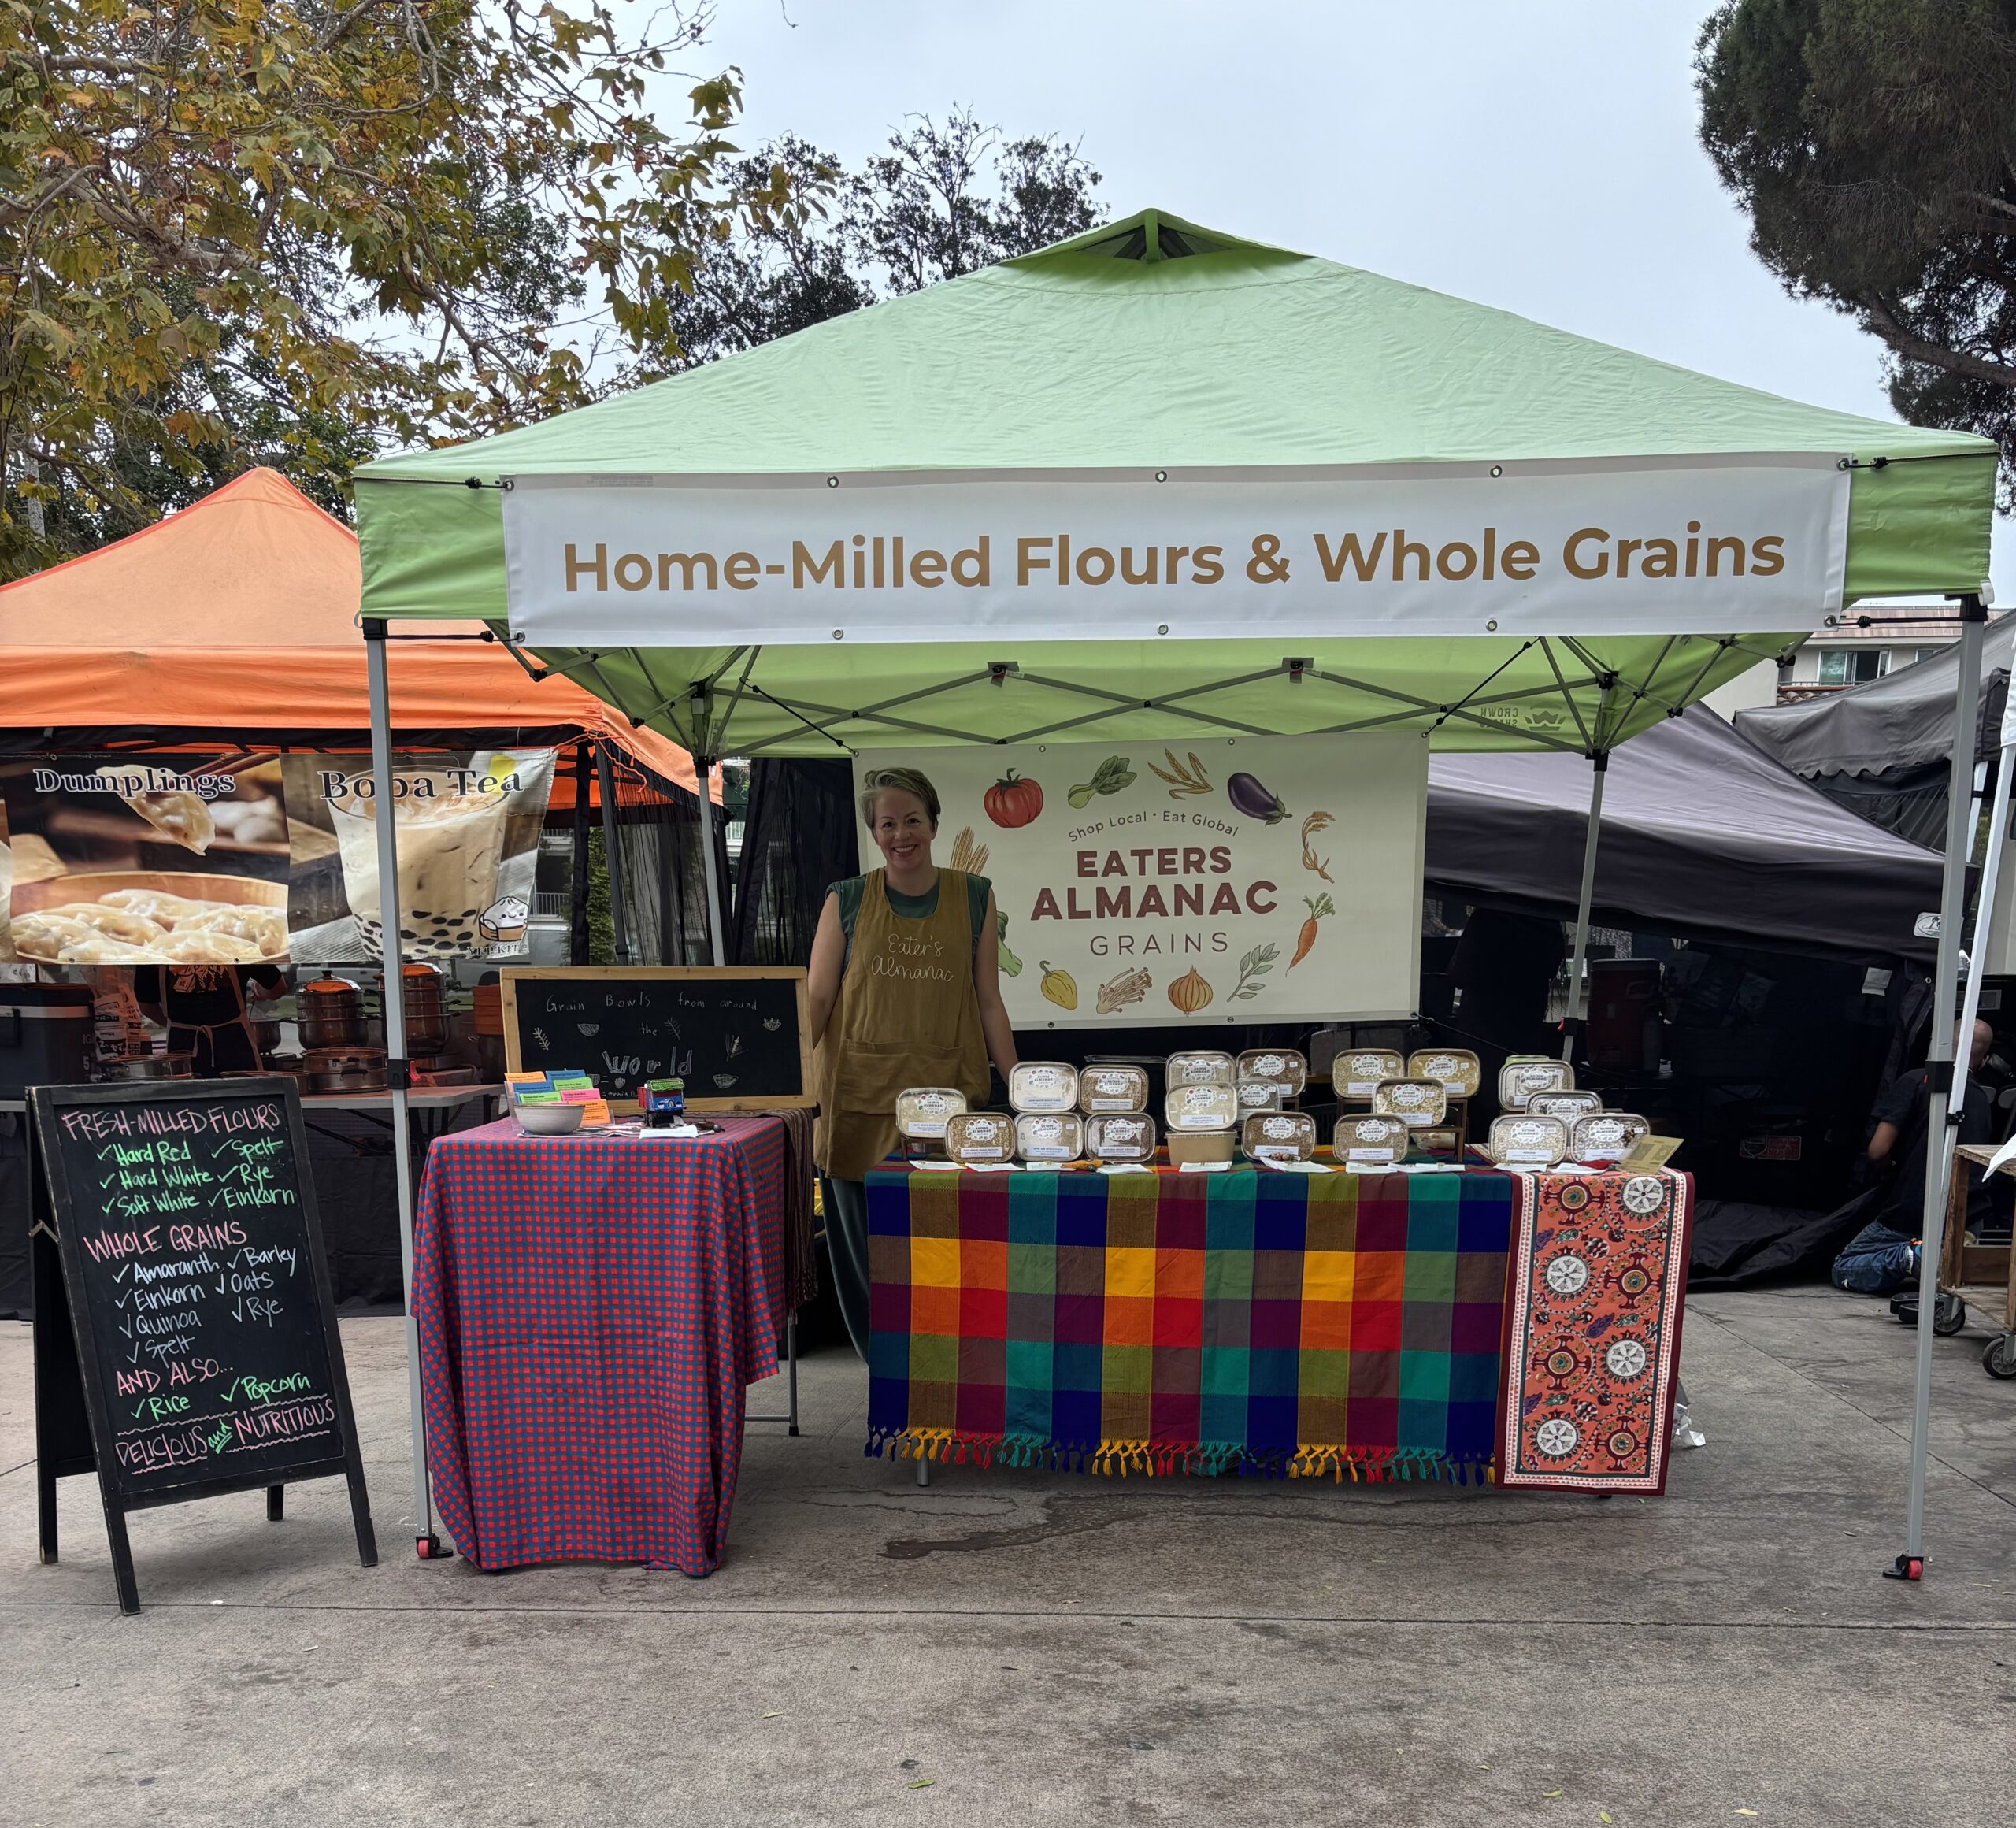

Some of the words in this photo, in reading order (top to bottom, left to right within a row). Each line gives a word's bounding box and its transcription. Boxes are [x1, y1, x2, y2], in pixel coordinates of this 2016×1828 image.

[564, 535, 990, 592] Home-Milled
[1017, 535, 1225, 586] Flours
[1244, 533, 1292, 584] &
[1313, 528, 1540, 583] Whole
[1562, 521, 1785, 579] Grains
[33, 768, 236, 799] Dumplings
[447, 770, 525, 797] Tea
[1068, 821, 1104, 843] Shop
[1109, 811, 1147, 828] Local
[1163, 810, 1186, 823] Eat
[1192, 814, 1239, 837] Global
[1077, 846, 1232, 878] EATERS
[1030, 880, 1277, 920] ALMANAC
[888, 933, 945, 957] Eater's
[1090, 932, 1228, 956] GRAINS
[547, 995, 584, 1012] Grain
[606, 991, 650, 1008] Bowls
[678, 991, 705, 1008] from
[719, 999, 757, 1011] around
[639, 1023, 658, 1036] the
[62, 1108, 207, 1141] FRESH-MILLED
[208, 1103, 280, 1134] FLOURS
[113, 1141, 154, 1166] Hard
[158, 1140, 191, 1165] Red
[232, 1136, 284, 1165] Spelt
[120, 1167, 158, 1190] Hard
[162, 1166, 213, 1188] White
[240, 1163, 274, 1192] Rye
[117, 1194, 150, 1217] Soft
[153, 1190, 200, 1213] White
[224, 1185, 295, 1208] Einkorn
[83, 1225, 163, 1263] WHOLE
[170, 1221, 247, 1253] GRAINS
[134, 1252, 220, 1285] Amaranth
[243, 1244, 297, 1277] Barley
[231, 1270, 275, 1293] Oats
[135, 1310, 202, 1336] Quinoa
[246, 1296, 284, 1327] Rye
[145, 1334, 195, 1368] Spelt
[116, 1369, 161, 1396] AND
[169, 1358, 234, 1386] ALSO...
[148, 1393, 191, 1421] Rice
[241, 1372, 311, 1404] Popcorn
[116, 1425, 208, 1466] DELICIOUS
[207, 1418, 232, 1448] and
[234, 1399, 335, 1444] NUTRITIOUS
